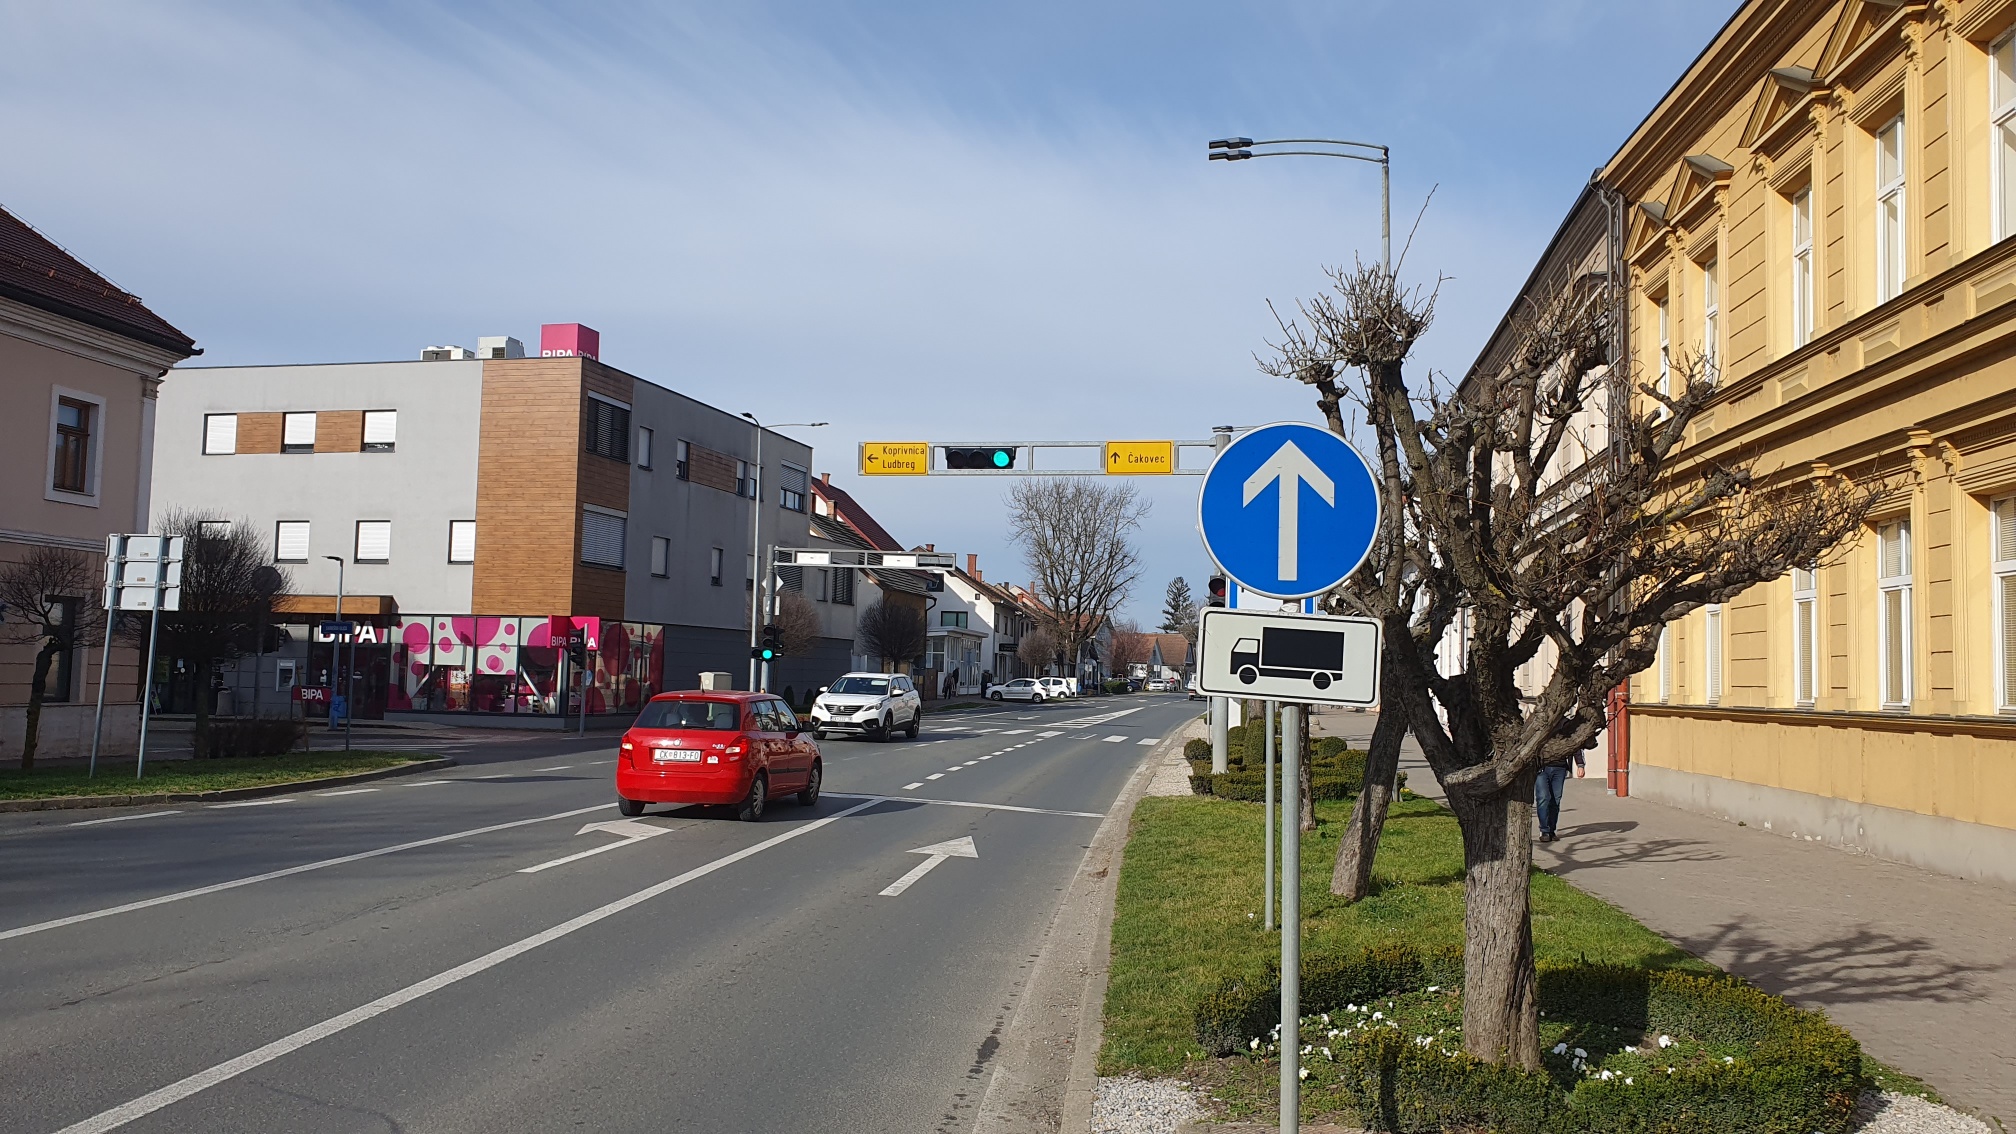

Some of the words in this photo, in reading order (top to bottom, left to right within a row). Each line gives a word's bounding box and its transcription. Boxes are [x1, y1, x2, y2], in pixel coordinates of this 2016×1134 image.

[882, 445, 925, 457] Koprivnica
[1128, 451, 1165, 464] Čakovec
[882, 459, 916, 471] Ludbreg
[551, 636, 567, 647] BIPA
[301, 688, 323, 700] BIPA
